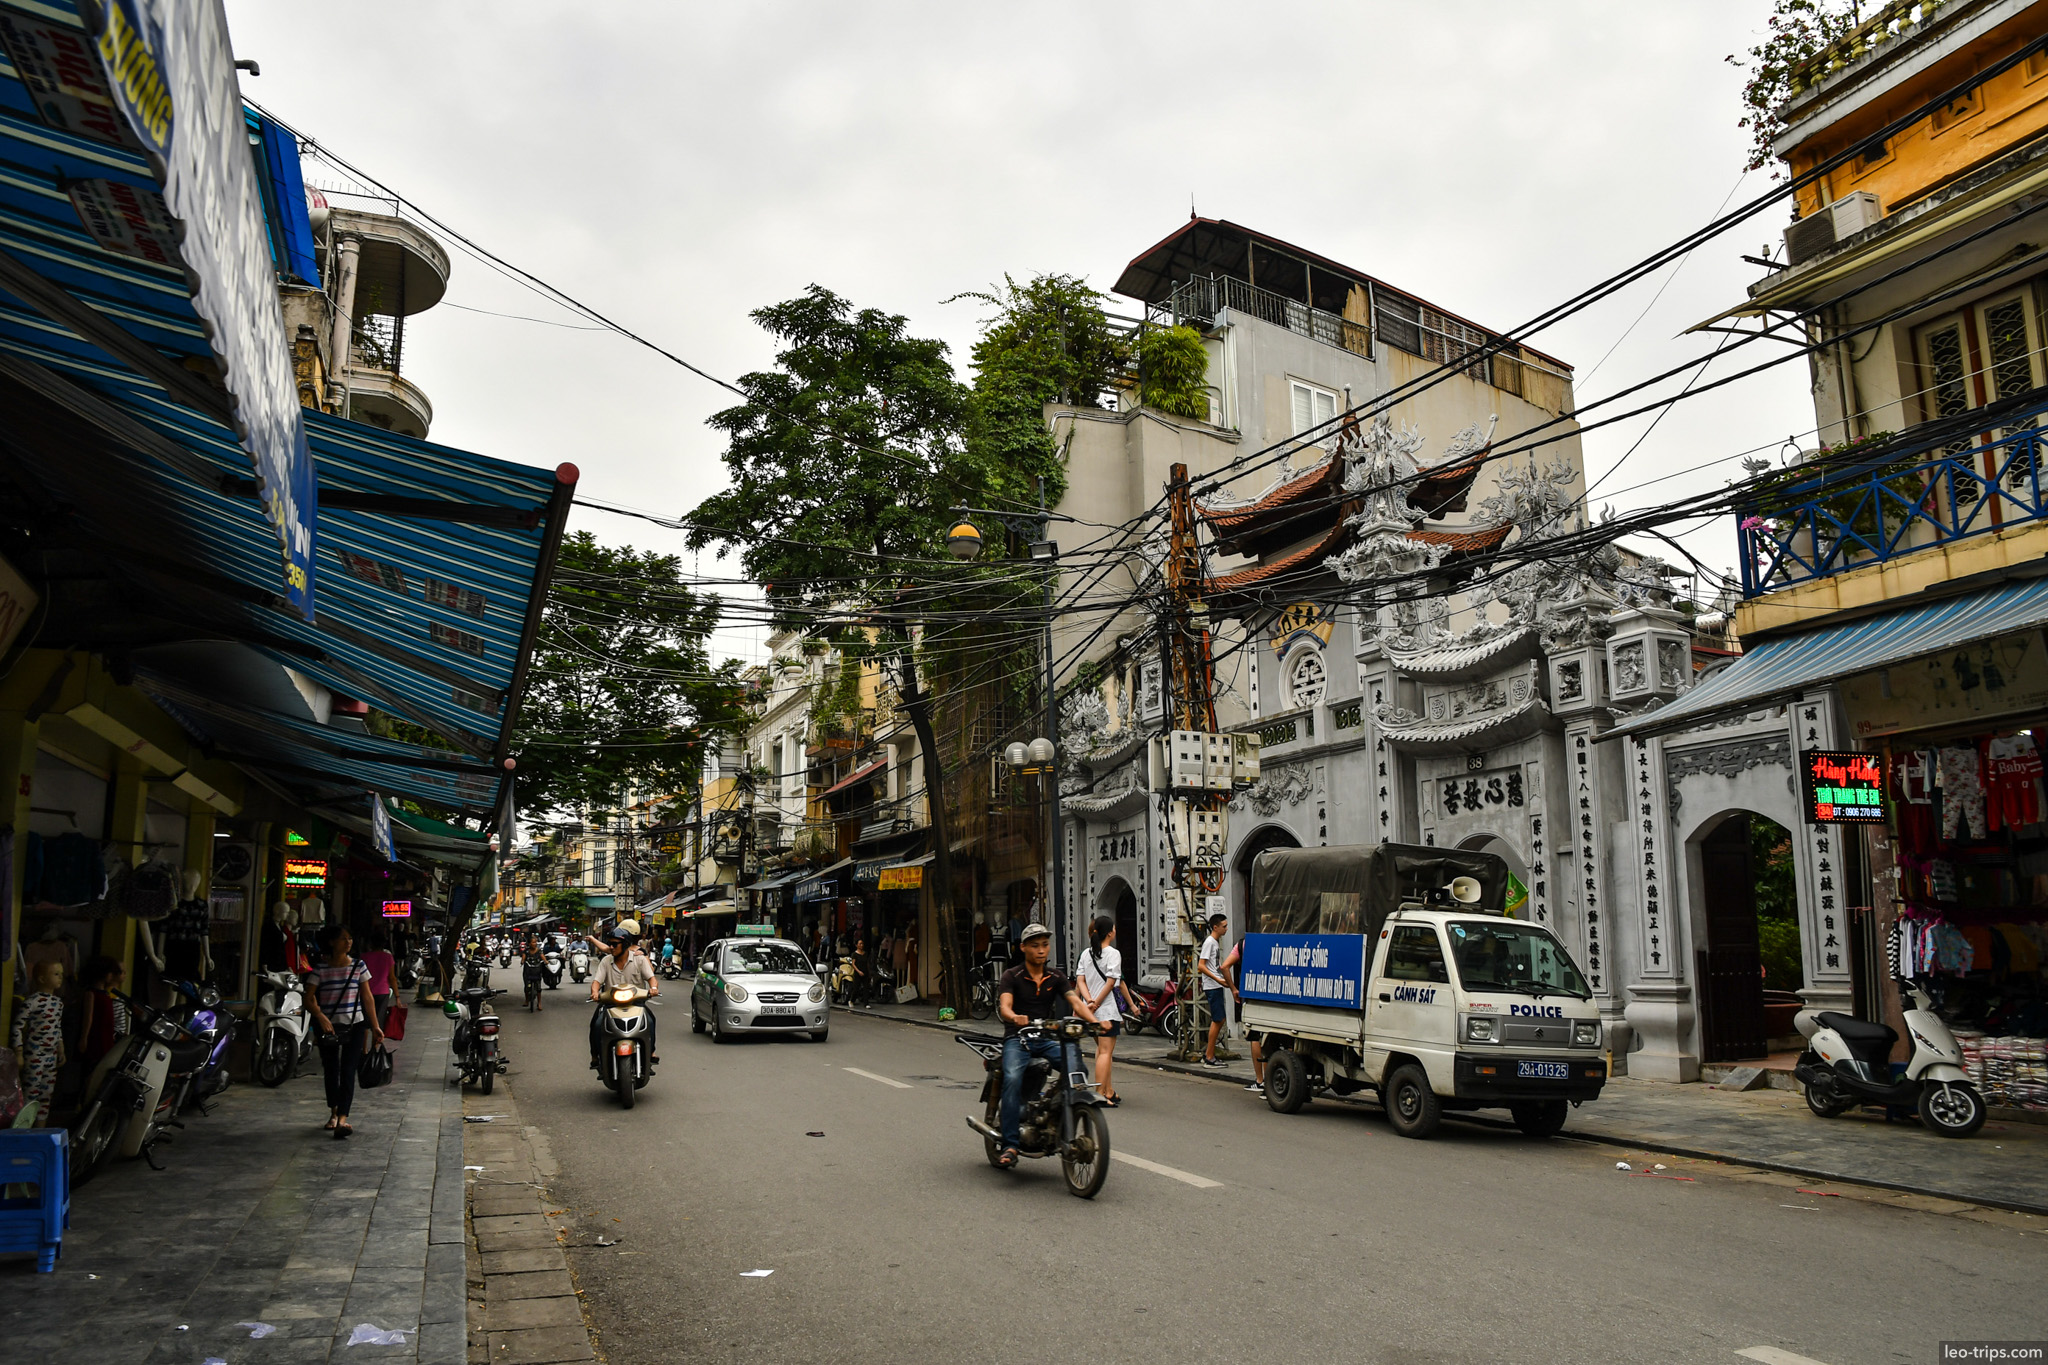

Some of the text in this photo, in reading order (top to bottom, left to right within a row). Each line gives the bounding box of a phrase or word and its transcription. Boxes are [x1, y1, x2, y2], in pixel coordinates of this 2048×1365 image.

[1469, 757, 1483, 769] 38
[1812, 757, 1846, 787] Hùng
[1998, 760, 2028, 774] Baby
[1833, 787, 1856, 804] TRANG
[1270, 941, 1328, 970] XÂY DỰNG NẾP SỐNG
[1256, 970, 1267, 993] HÓA
[1268, 974, 1281, 994] GIAO
[1303, 973, 1316, 997] VĂN
[1316, 978, 1333, 999] MINH
[1334, 975, 1343, 999] ĐÔ
[1344, 980, 1355, 1005] THỊ
[1394, 981, 1436, 1004] CẢNH SÁT
[1510, 1004, 1562, 1018] POLICE
